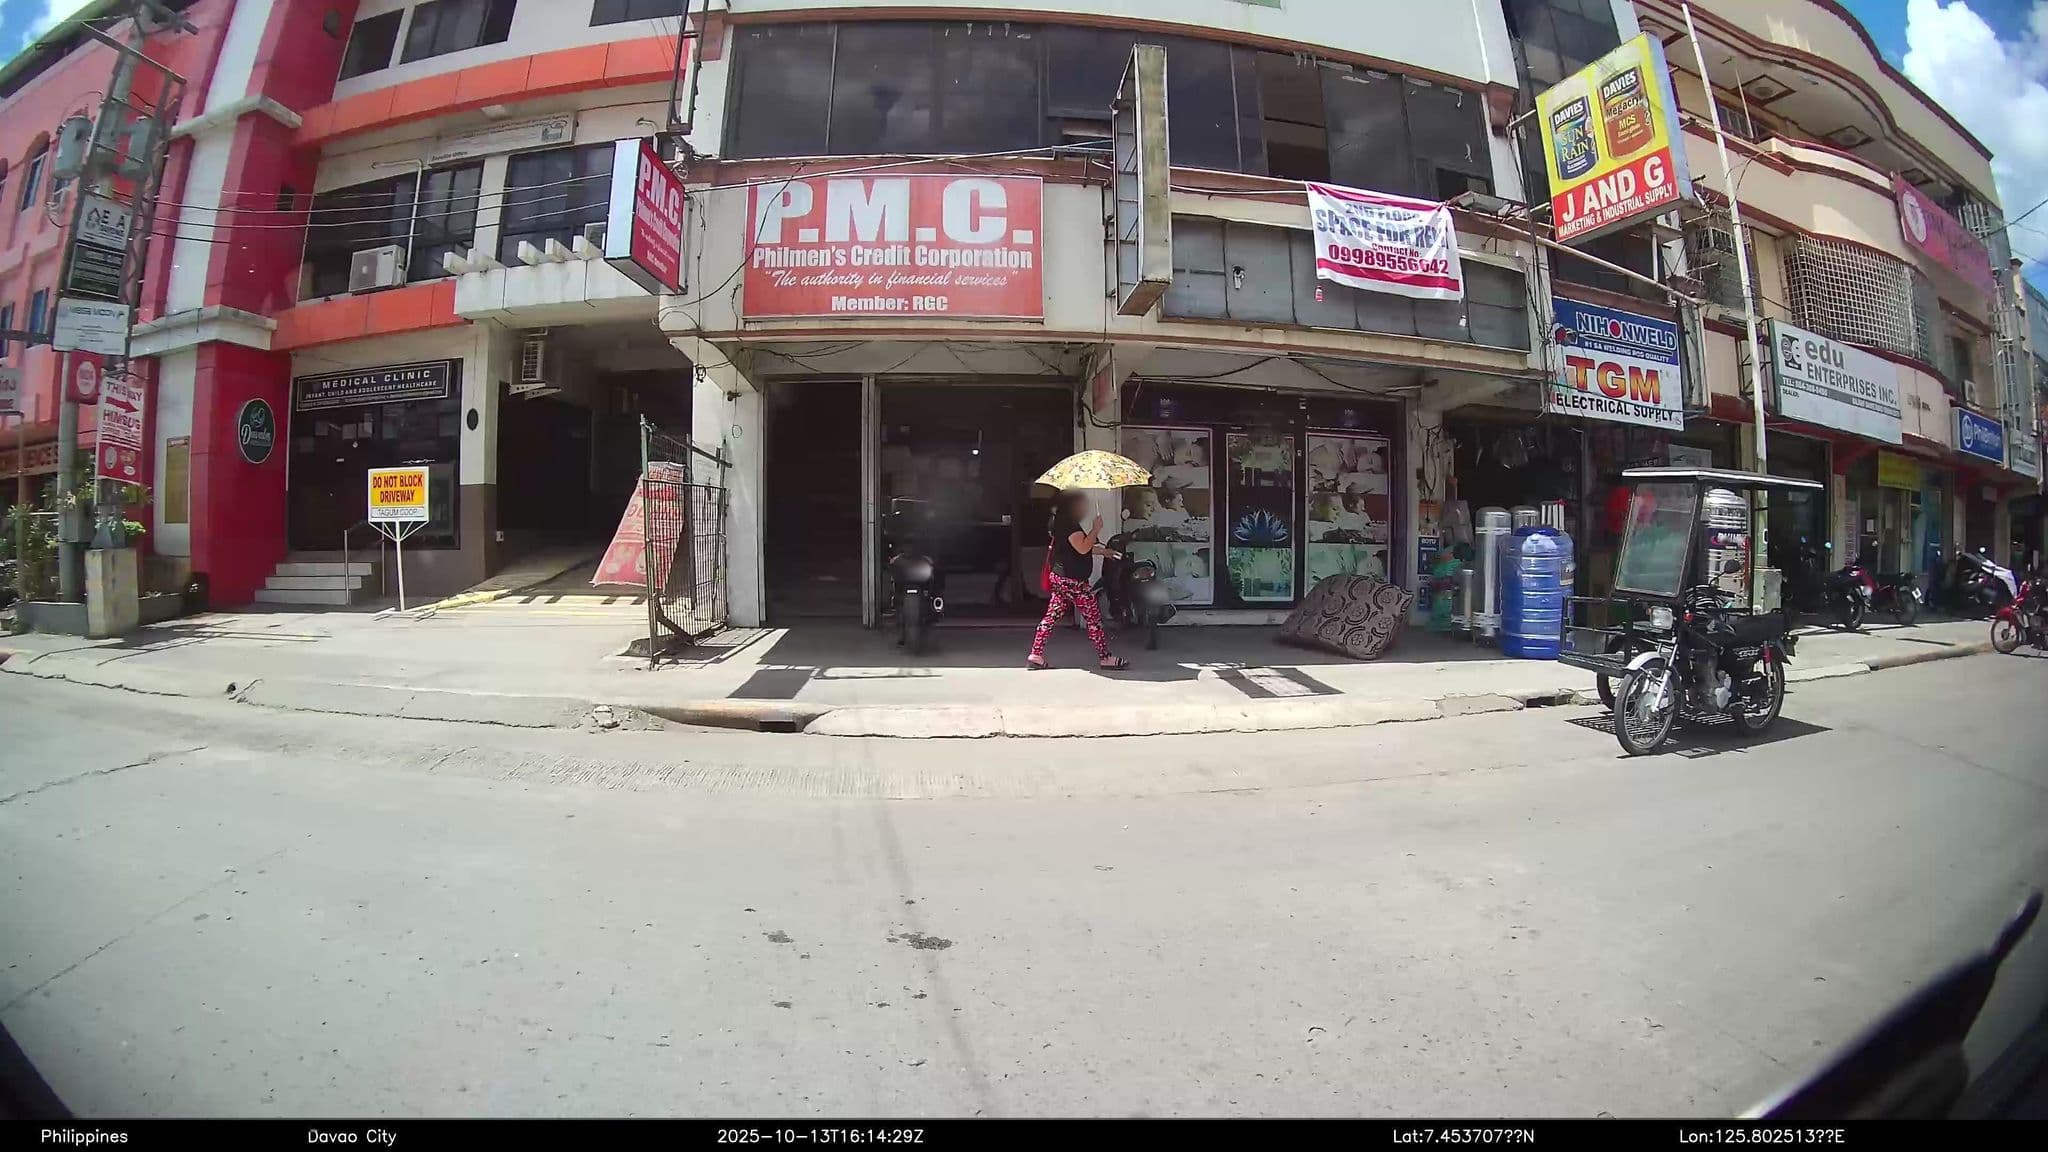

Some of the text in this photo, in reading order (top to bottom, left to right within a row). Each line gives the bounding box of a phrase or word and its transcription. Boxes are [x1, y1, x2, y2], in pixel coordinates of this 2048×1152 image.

[1604, 71, 1637, 99] DAVIES
[1555, 101, 1584, 125] DAVIES
[1560, 125, 1584, 146] SUN
[1562, 140, 1589, 162] RAIN
[637, 151, 682, 231] P.M.C.
[1562, 156, 1665, 221] J AND G
[754, 178, 1034, 245] P.M.C.
[1558, 182, 1673, 236] MARKETING & INDUSTRIAL SUPPLY
[1315, 209, 1374, 241] SPACE
[753, 245, 1033, 269] Philmen's Credit Corporation
[1371, 243, 1408, 257] Contact
[801, 269, 872, 289] authority
[868, 273, 884, 286] in
[885, 270, 953, 290] financial
[831, 295, 949, 312] Member: RGC
[1575, 311, 1678, 351] NIHONWELD
[1603, 344, 1631, 356] WELDING
[1645, 353, 1670, 363] QUALITY
[1805, 340, 1846, 371] edu
[322, 370, 431, 389] MEDICAL CLINIC
[328, 389, 345, 397] CHILD
[358, 384, 396, 394] ADOLESCENT
[398, 380, 437, 390] HEALTHCARE
[1565, 355, 1662, 404] TGM
[1806, 362, 1877, 399] ENTERPRISES
[1878, 384, 1898, 406] INC.
[1556, 393, 1674, 422] ELECTRICAL SUPPLY
[373, 474, 423, 488] DO NOT BLOCK
[380, 490, 415, 503] DRIVEWAY
